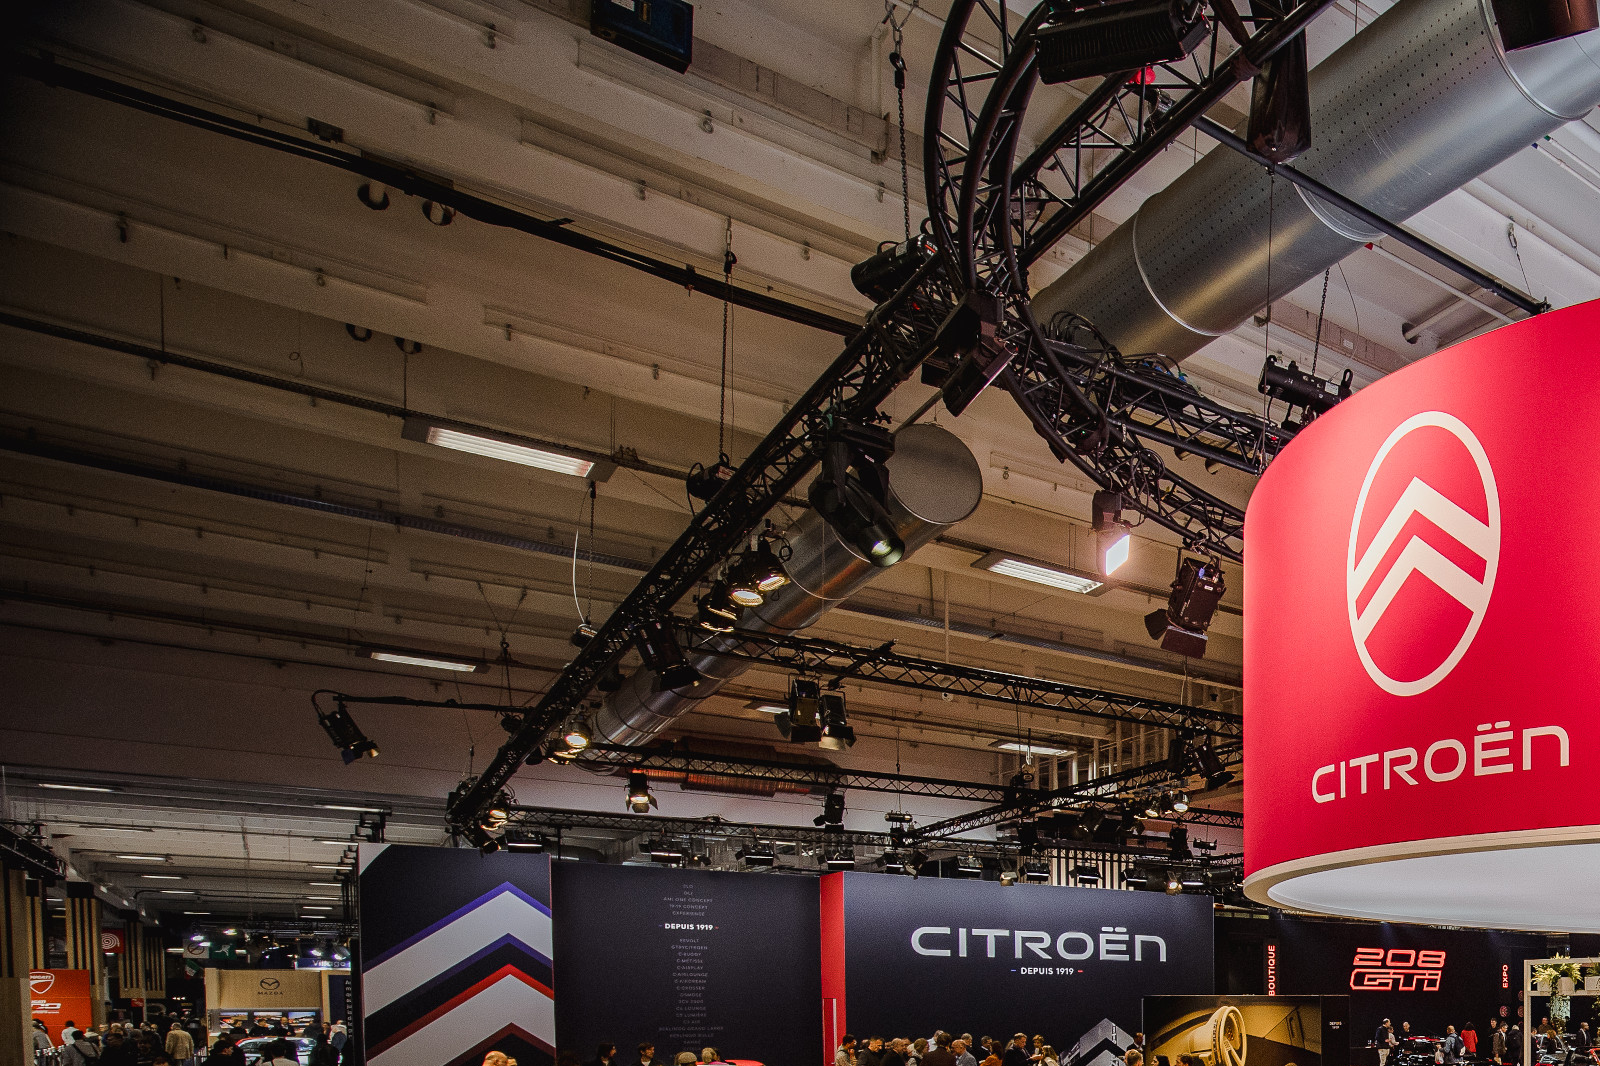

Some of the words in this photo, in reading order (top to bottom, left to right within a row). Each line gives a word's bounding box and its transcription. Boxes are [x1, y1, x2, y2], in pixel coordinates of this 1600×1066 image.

[911, 926, 1167, 962] CITROËN
[1353, 947, 1446, 968] 208
[1020, 967, 1054, 975] DEPUIS
[1056, 968, 1074, 976] 1919
[1268, 945, 1276, 996] BOUTIQUE
